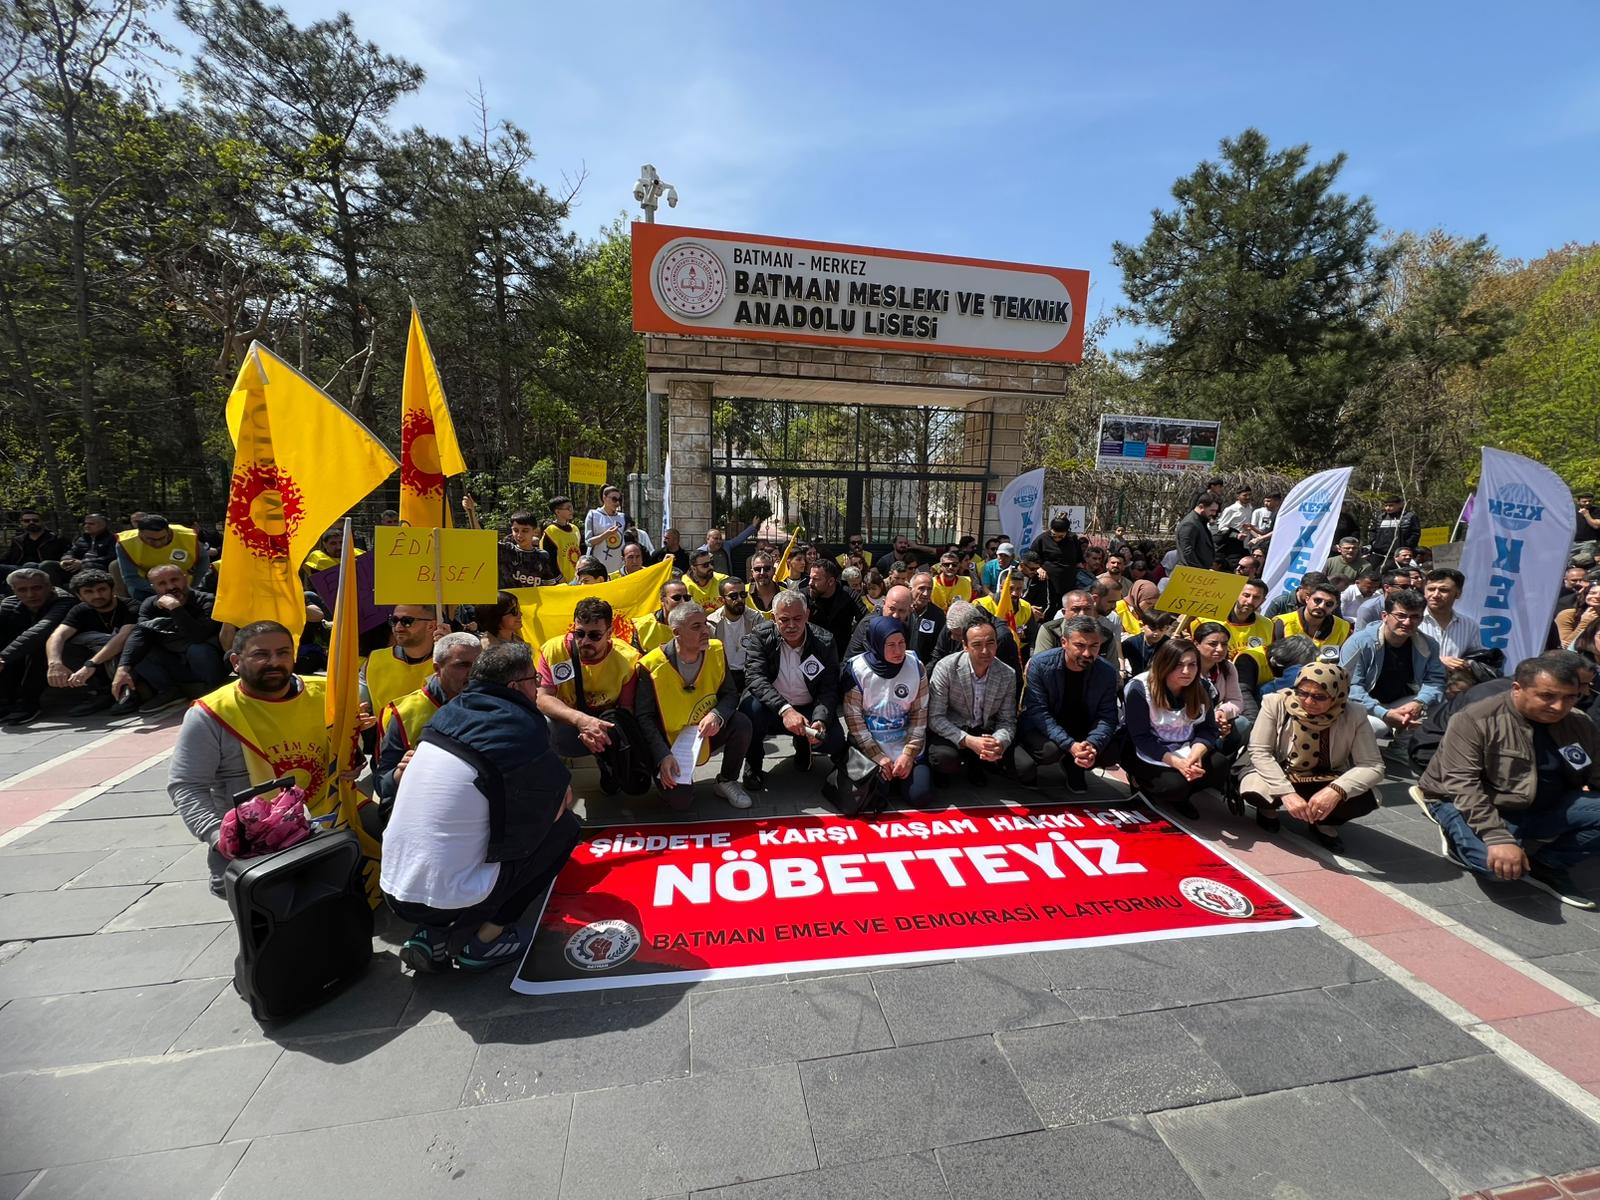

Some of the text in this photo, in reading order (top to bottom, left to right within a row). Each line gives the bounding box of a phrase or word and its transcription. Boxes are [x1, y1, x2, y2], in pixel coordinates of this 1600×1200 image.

[733, 248, 793, 268] BATMAN
[811, 255, 867, 276] MERKEZ
[734, 270, 840, 303] BATMAN
[957, 291, 986, 317] VE
[734, 300, 856, 333] ANADOLU
[512, 570, 542, 587] Jeep
[1180, 572, 1220, 586] YUSUF
[1283, 525, 1319, 595] KES
[589, 832, 732, 858] ŞİDDETE
[758, 825, 859, 845] KARŞI
[868, 819, 978, 840] YAŞAM
[1083, 808, 1152, 828] İÇİN
[653, 831, 1149, 907] NÖBETTEYİZ
[652, 927, 766, 950] BATMAN
[774, 919, 849, 941] EMEK
[854, 917, 889, 934] VE
[895, 903, 1040, 932] DEMOKRASİ
[1042, 894, 1185, 920] PLATFORMU
